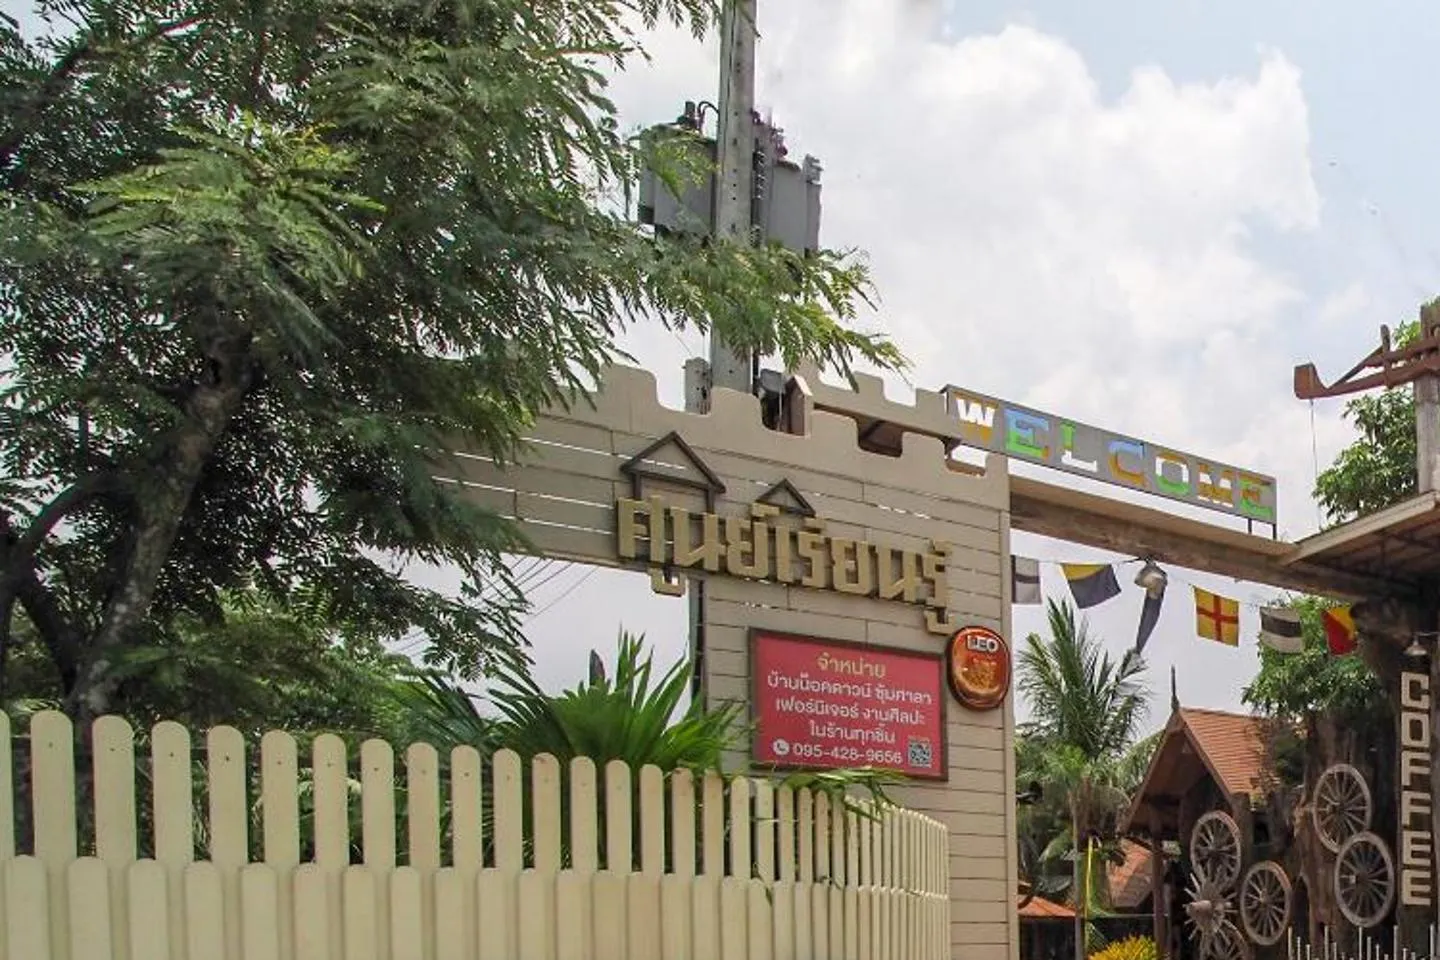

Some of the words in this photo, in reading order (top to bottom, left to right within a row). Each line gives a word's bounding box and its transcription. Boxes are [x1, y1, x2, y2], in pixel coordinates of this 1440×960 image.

[955, 390, 1275, 518] WELCOME
[615, 494, 957, 636] ศูนย์เรียนรู้
[816, 651, 887, 679] จำหน่าย
[874, 683, 933, 706] ซุ้มศาลา
[775, 697, 860, 719] เฟอร์นิเจอร์
[862, 706, 926, 726] งานศิลปะ
[809, 719, 897, 746] ในร้านทุกชิ้น
[792, 742, 904, 765] 095-428-9656
[1401, 672, 1432, 906] COFFEE
